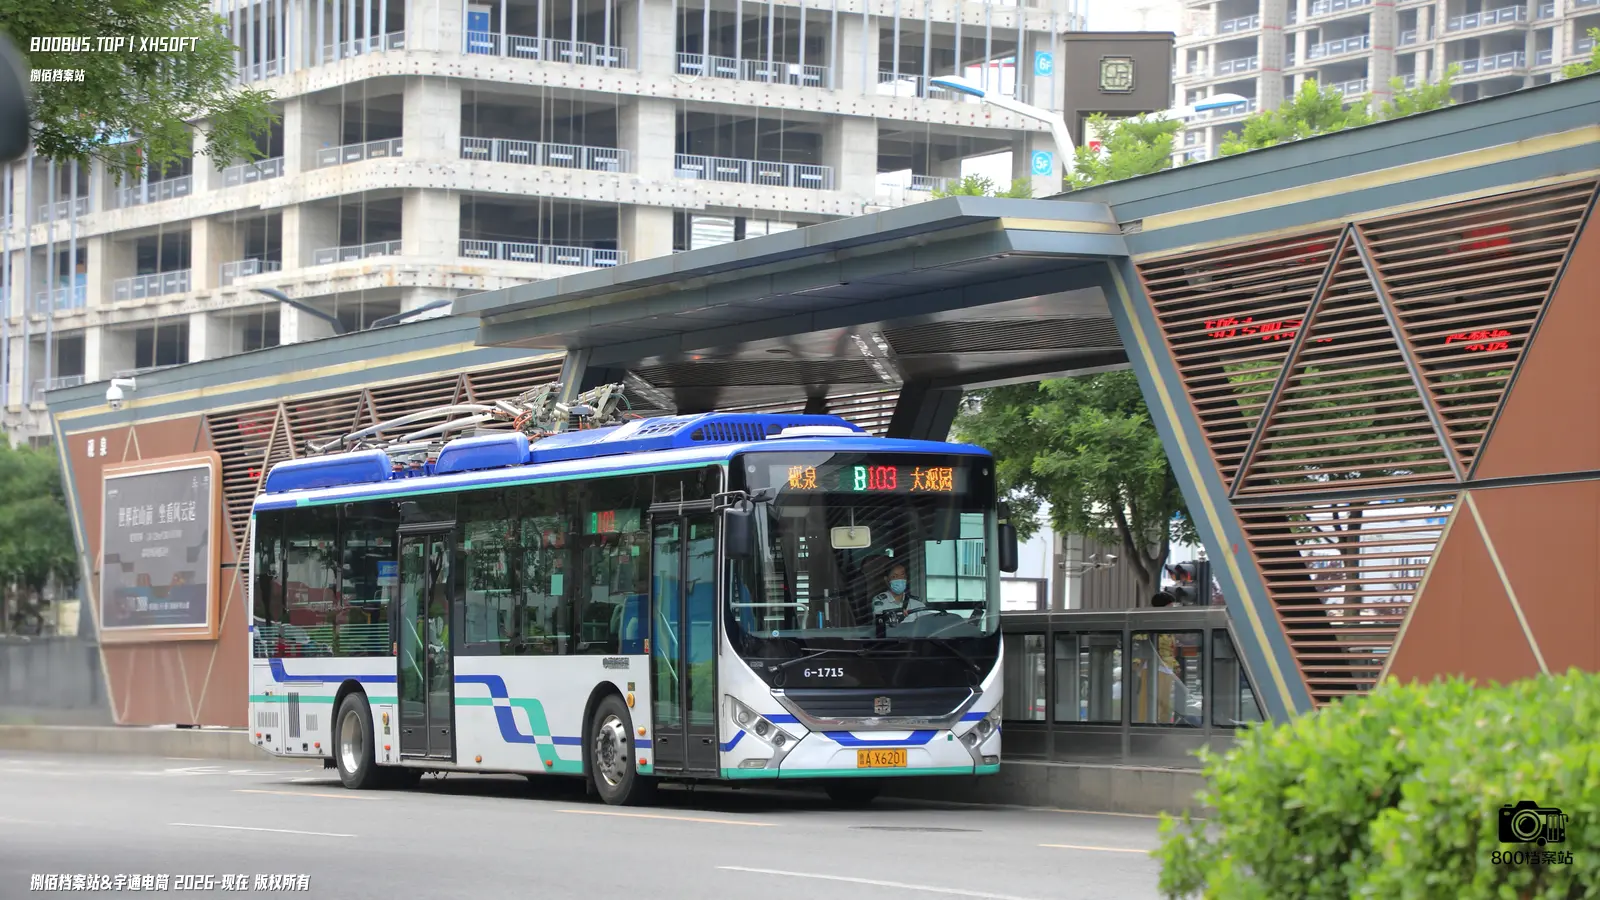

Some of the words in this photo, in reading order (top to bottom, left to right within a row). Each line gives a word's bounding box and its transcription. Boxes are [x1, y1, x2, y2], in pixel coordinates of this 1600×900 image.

[1039, 58, 1052, 70] 6F
[1035, 158, 1048, 169] 5F
[854, 466, 897, 491] B103
[910, 466, 953, 492] 大观园
[804, 668, 844, 678] 6-1715
